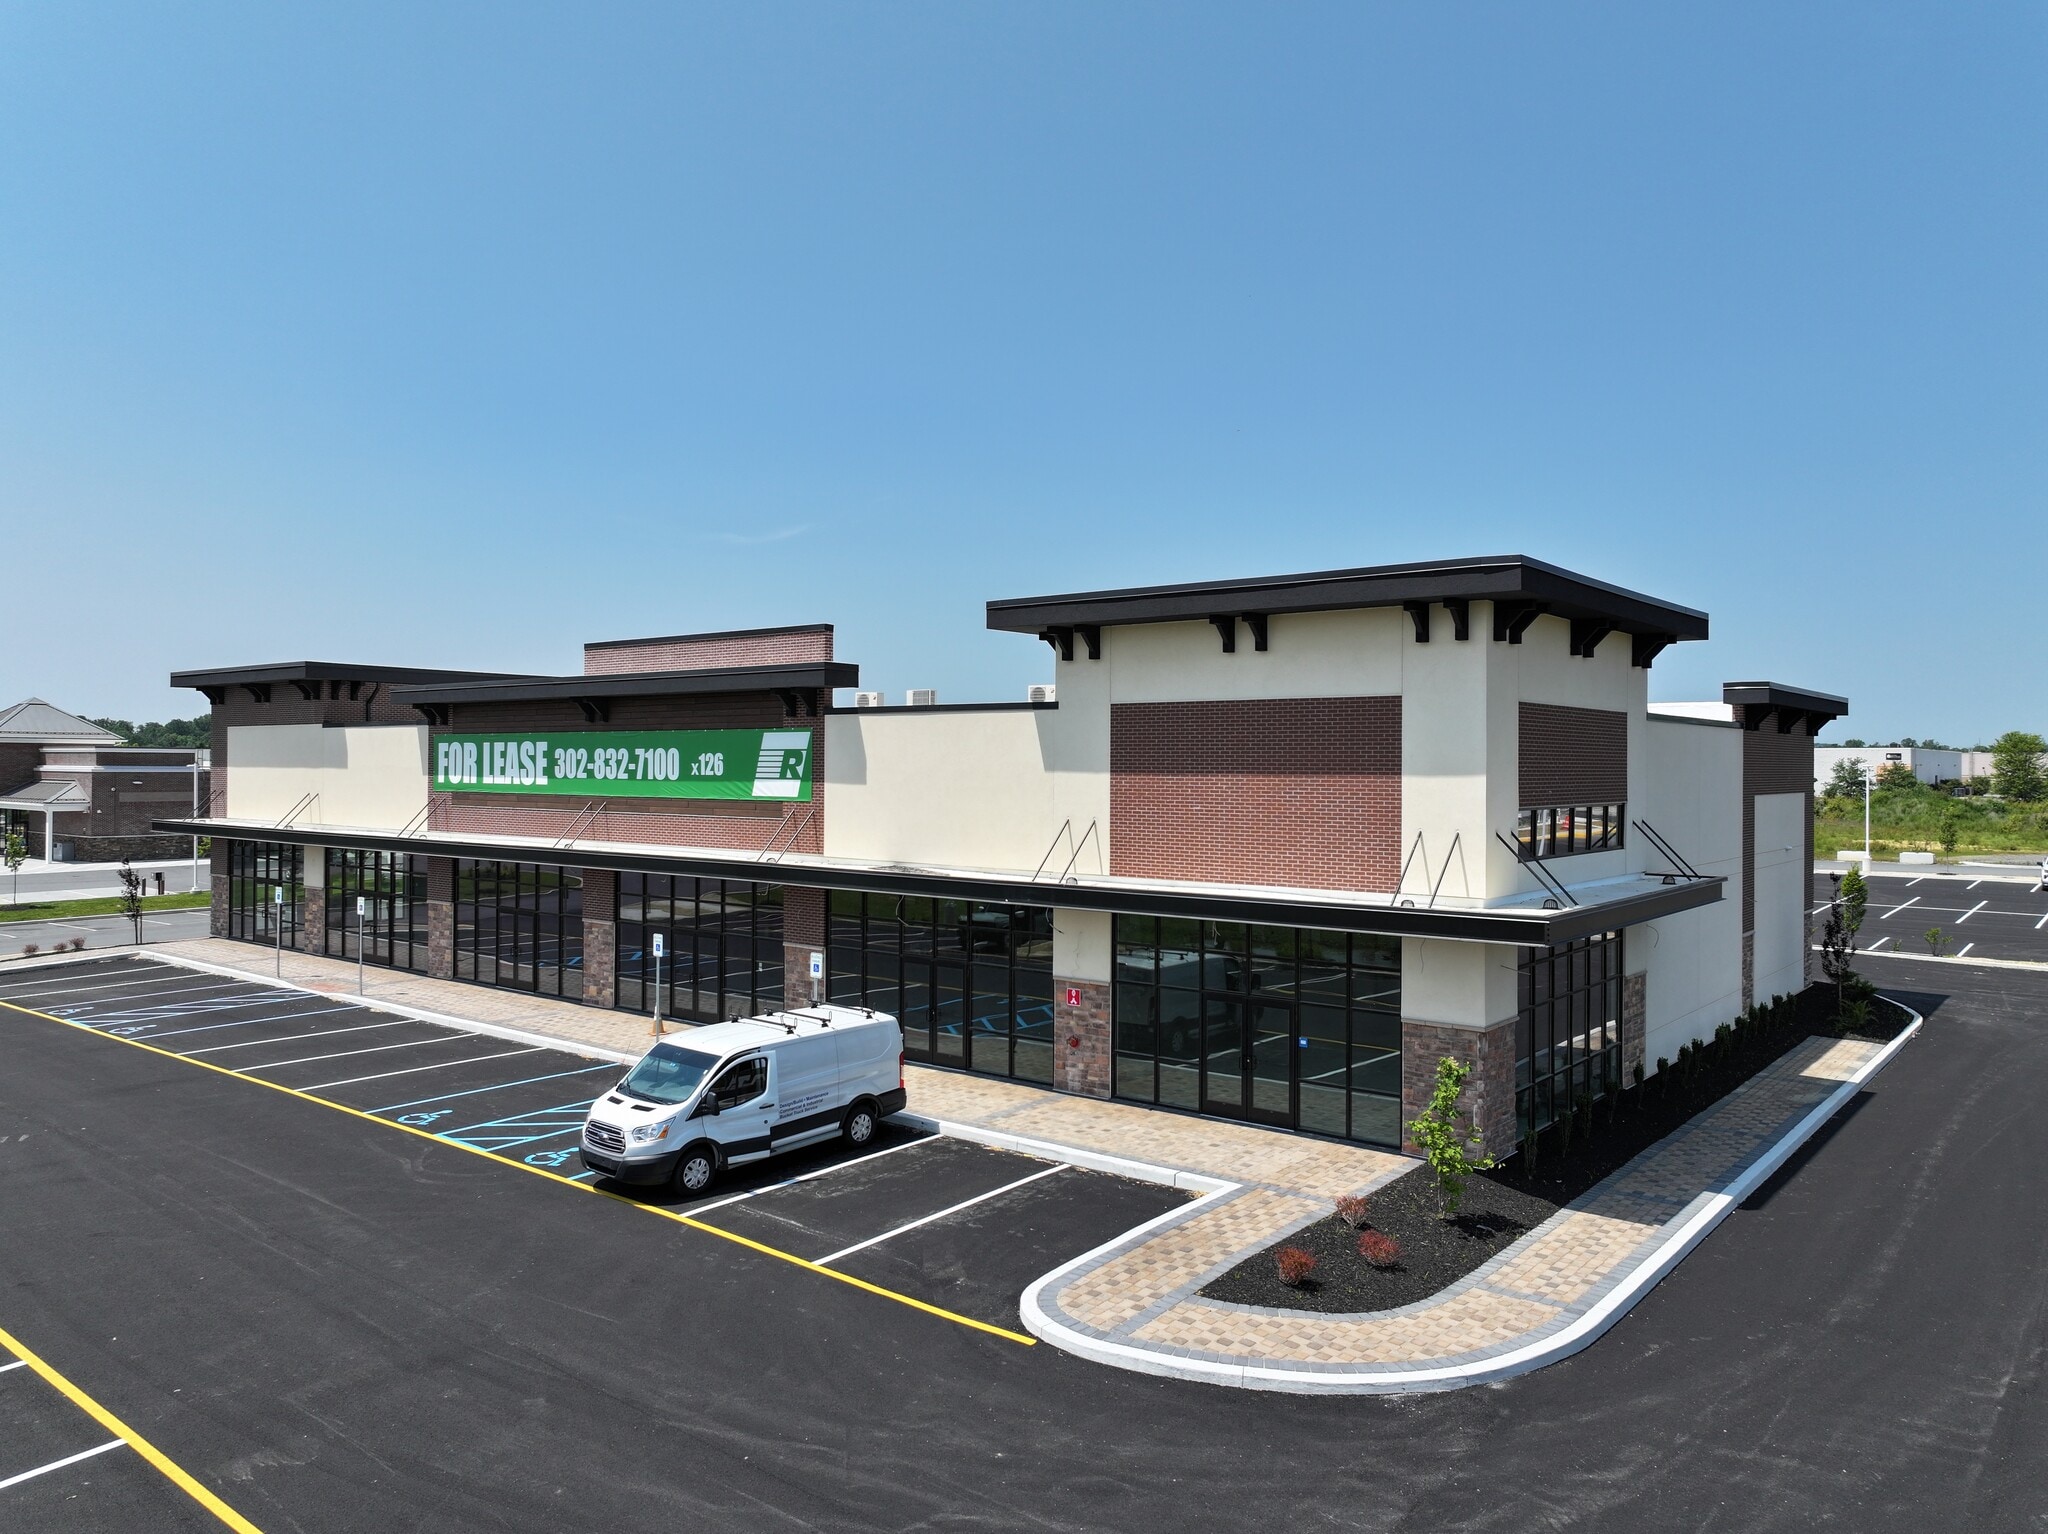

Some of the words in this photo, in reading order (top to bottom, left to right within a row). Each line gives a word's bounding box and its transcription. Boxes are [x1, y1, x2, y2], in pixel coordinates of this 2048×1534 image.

[438, 741, 477, 783] FOR
[483, 741, 548, 785] LEASE
[554, 748, 680, 780] 302-832-7100
[691, 753, 724, 777] x126
[806, 1092, 828, 1101] Maintenance
[780, 1104, 802, 1114] Commercial
[806, 1098, 823, 1106] Industrial
